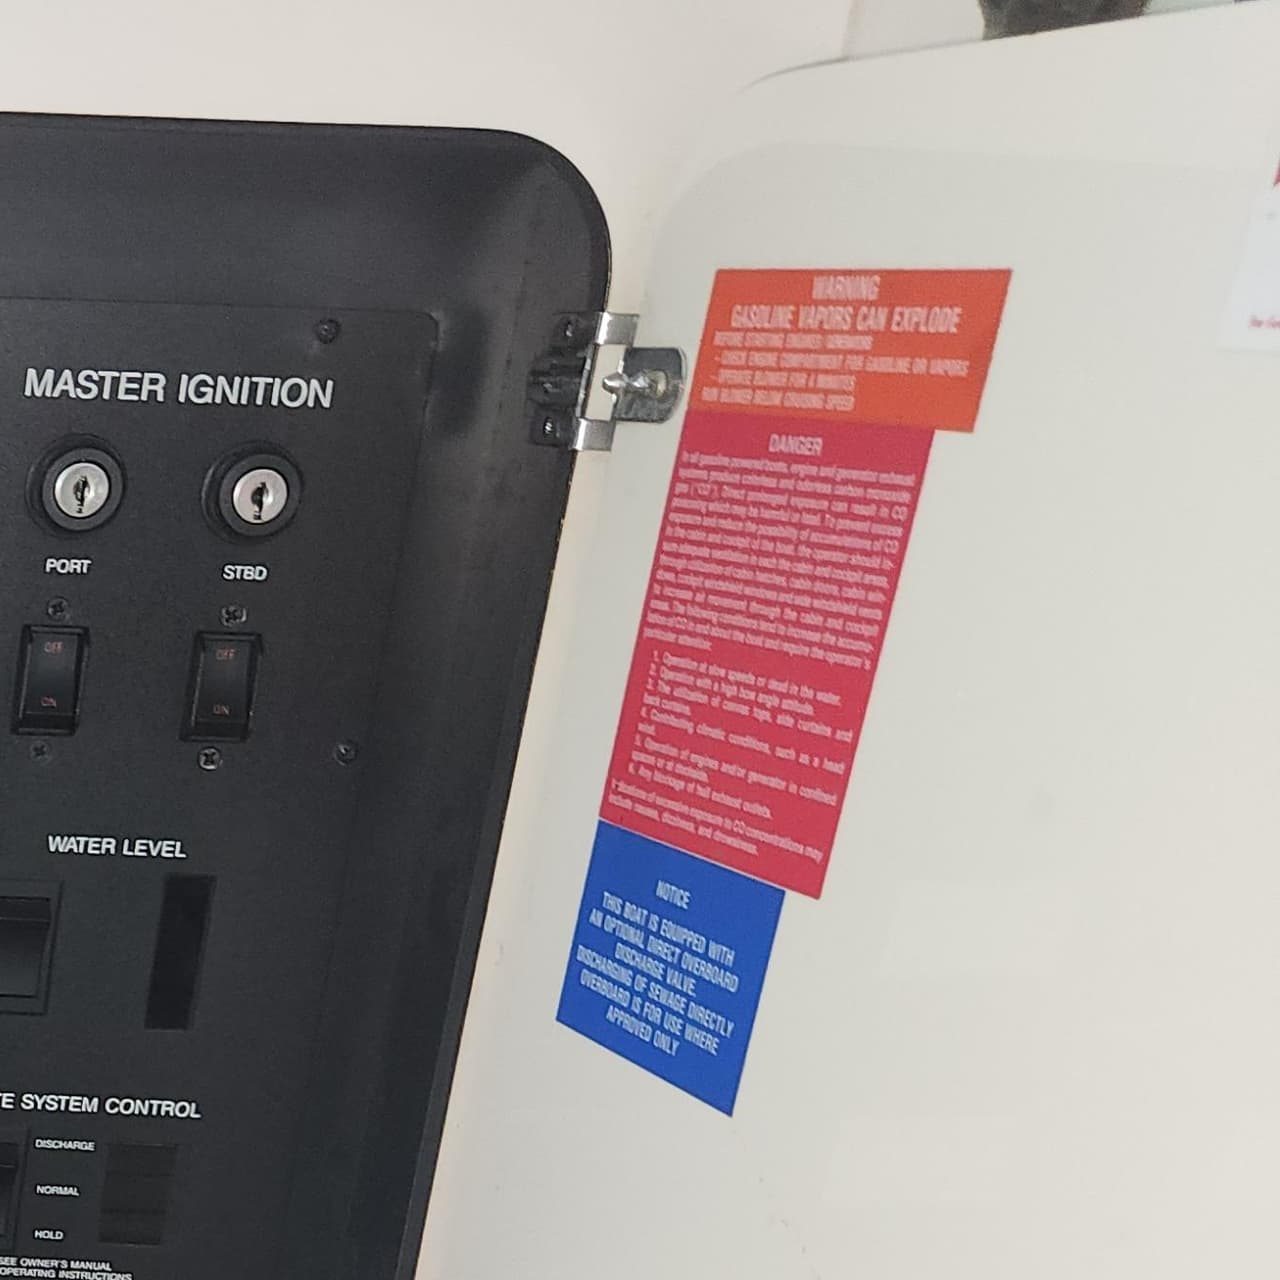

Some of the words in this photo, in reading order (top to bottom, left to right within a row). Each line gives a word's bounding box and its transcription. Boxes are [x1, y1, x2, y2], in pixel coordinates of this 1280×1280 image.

[731, 305, 794, 328] GASOLINE
[798, 306, 853, 330] VAPORS
[856, 307, 888, 331] CAN
[892, 307, 962, 333] EXPLODE
[24, 367, 166, 402] MASTER
[178, 373, 334, 408] IGNITION
[769, 434, 822, 456] DANGER
[45, 558, 92, 574] PORT
[222, 564, 268, 581] STBD
[48, 835, 116, 855] WATER
[122, 838, 187, 858] LEVEL
[656, 880, 691, 909] NOTICE
[603, 892, 622, 915] THIS
[623, 902, 647, 924] BOAT
[649, 913, 659, 932] IS
[661, 919, 705, 953] EQUIPPED
[708, 940, 735, 966] WITH
[589, 908, 603, 928] AN
[604, 915, 645, 948] OPTIONAL
[647, 935, 681, 963] DIRECT
[681, 952, 738, 992] OVERBOARD
[615, 943, 665, 980] DISCHARGE
[577, 945, 633, 986] DISCHARGING
[634, 974, 647, 991] OF
[648, 982, 687, 1014] SEWAGE
[688, 1002, 735, 1038] DIRECTLY
[581, 969, 630, 1007] OVERBOARD
[632, 997, 642, 1014] IS
[643, 1002, 662, 1025] FOR
[664, 1012, 683, 1035] USE
[685, 1023, 719, 1056] WHERE
[606, 1005, 652, 1042] APPROVED
[654, 1030, 680, 1056] ONLY
[20, 1093, 99, 1113] SYSTEM
[104, 1097, 201, 1119] CONTROL
[35, 1138, 95, 1151] DISCHARGE
[36, 1185, 80, 1196] NORMAL
[34, 1229, 64, 1240] HOLD
[19, 1257, 69, 1269] OWNER'S
[70, 1260, 112, 1272] MANUAL
